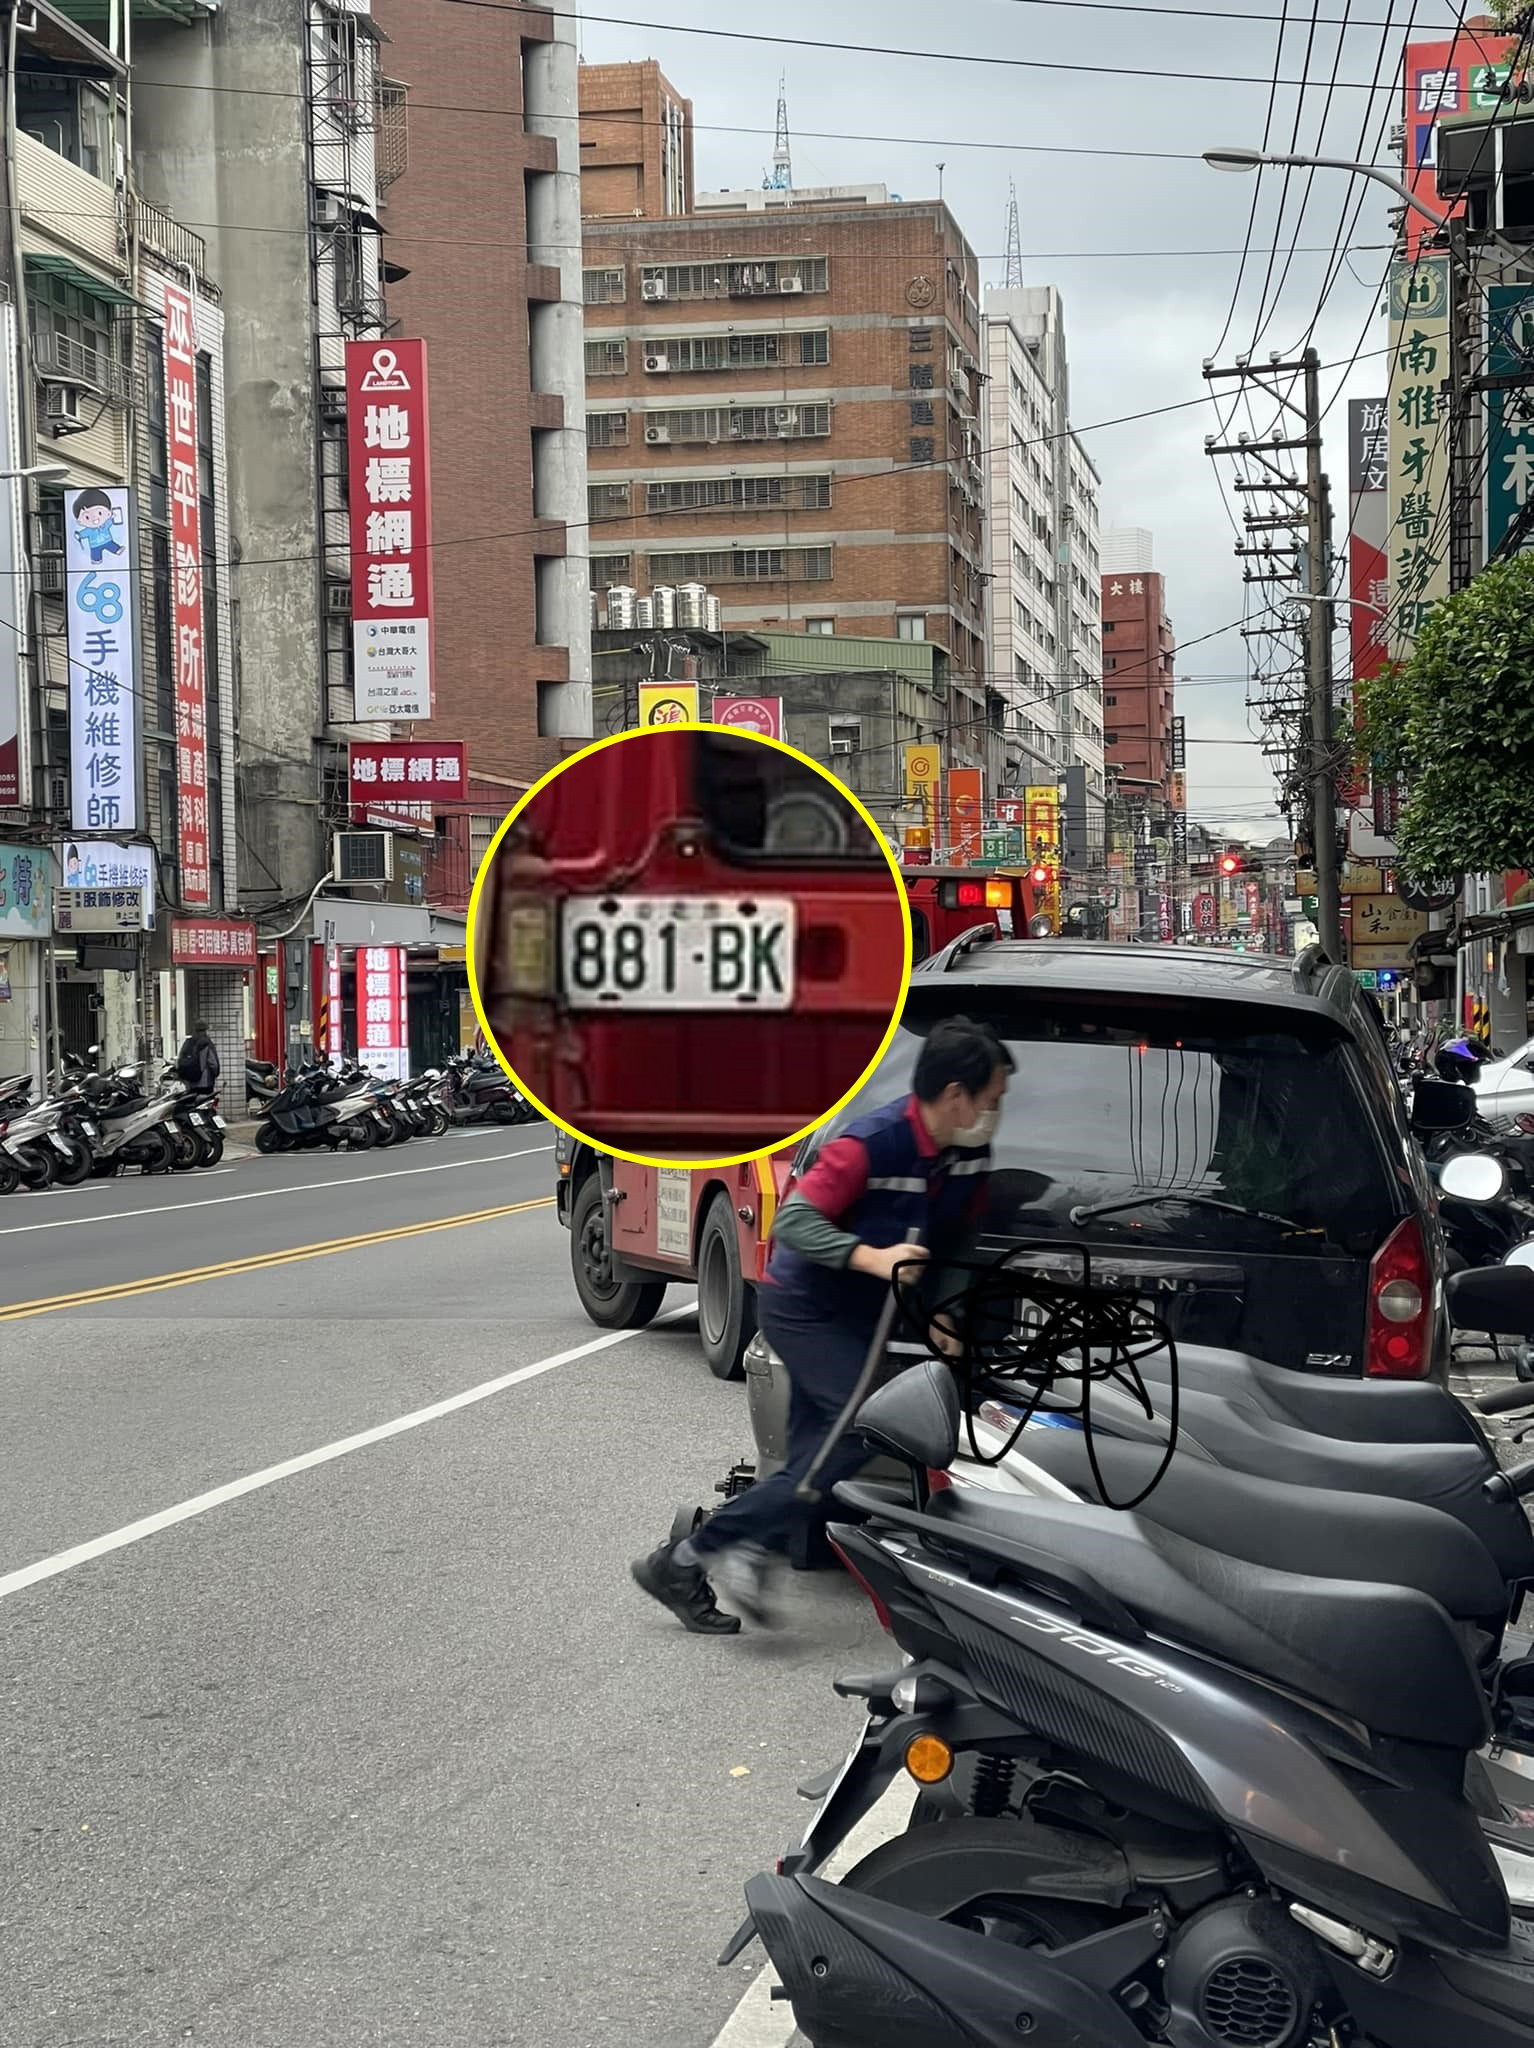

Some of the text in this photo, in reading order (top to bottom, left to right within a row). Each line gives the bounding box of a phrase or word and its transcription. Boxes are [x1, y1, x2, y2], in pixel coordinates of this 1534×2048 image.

[168, 295, 200, 690] 巫世平診所
[364, 404, 414, 608] 地標網通
[1397, 328, 1442, 635] 南雅牙醫診所
[378, 646, 417, 657] 台灣大哥大
[380, 625, 416, 635] 中華電信
[83, 628, 121, 829] 手機維修師
[352, 757, 461, 782] 地標網通
[83, 891, 139, 908] 服飾修改
[365, 947, 392, 1047] 地標網通
[1001, 1265, 1179, 1292] AVRIN
[1010, 1616, 1167, 1678] JOG
